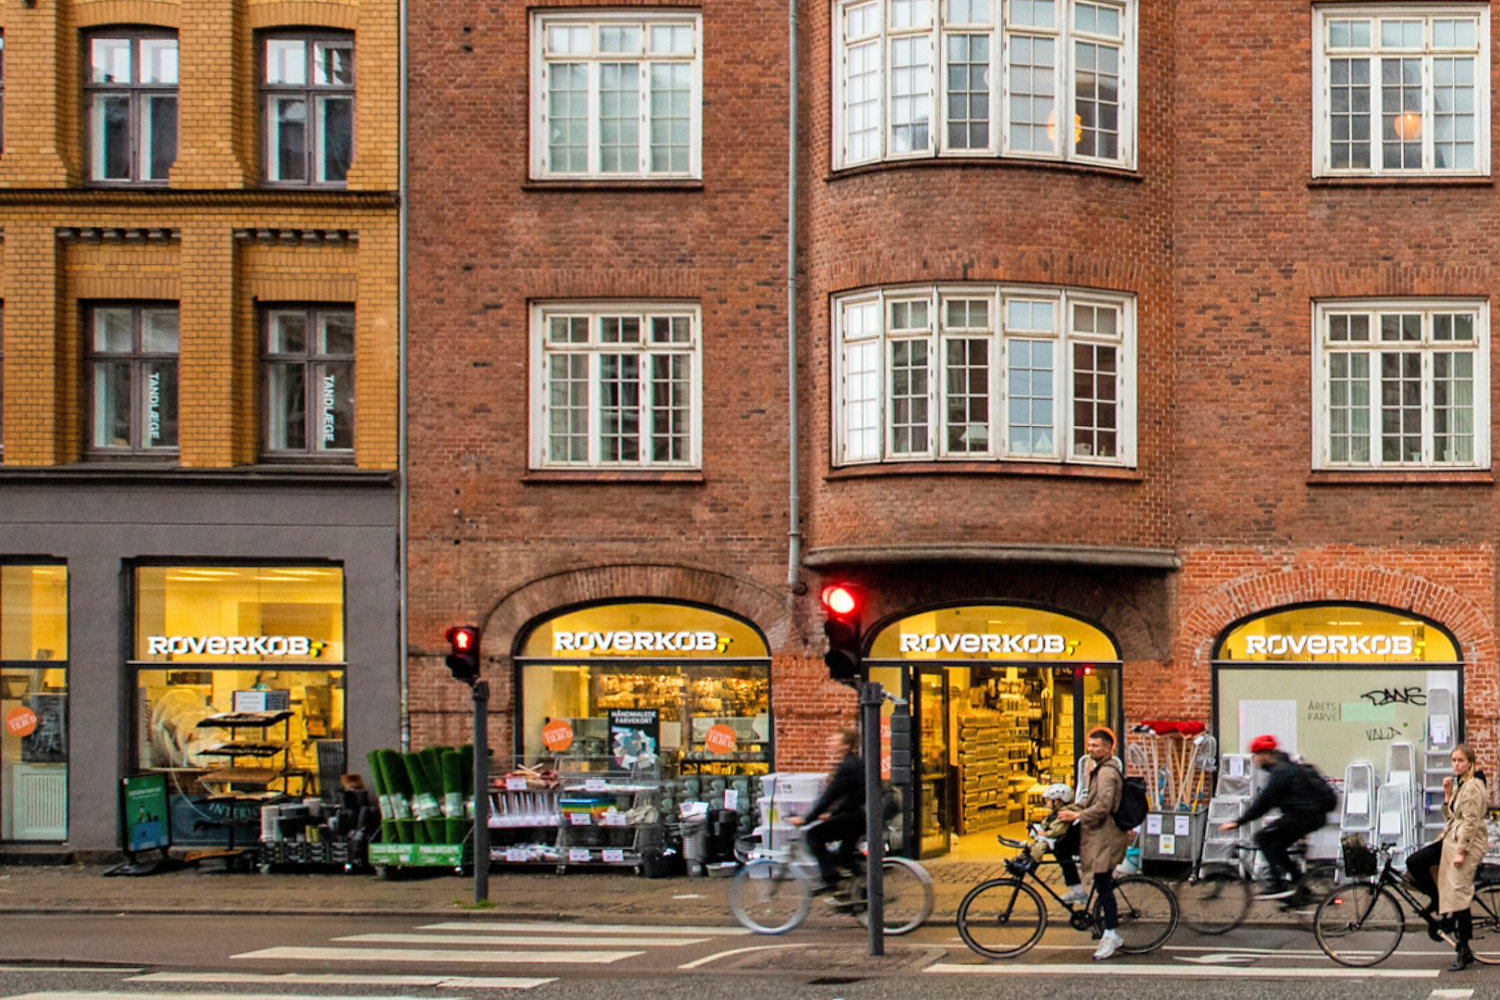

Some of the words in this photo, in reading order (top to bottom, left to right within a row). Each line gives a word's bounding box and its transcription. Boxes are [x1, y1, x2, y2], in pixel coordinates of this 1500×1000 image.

[149, 372, 160, 439] TANDLÆGE
[324, 374, 335, 442] TANDLÆGE
[1307, 711, 1337, 721] FARVE
